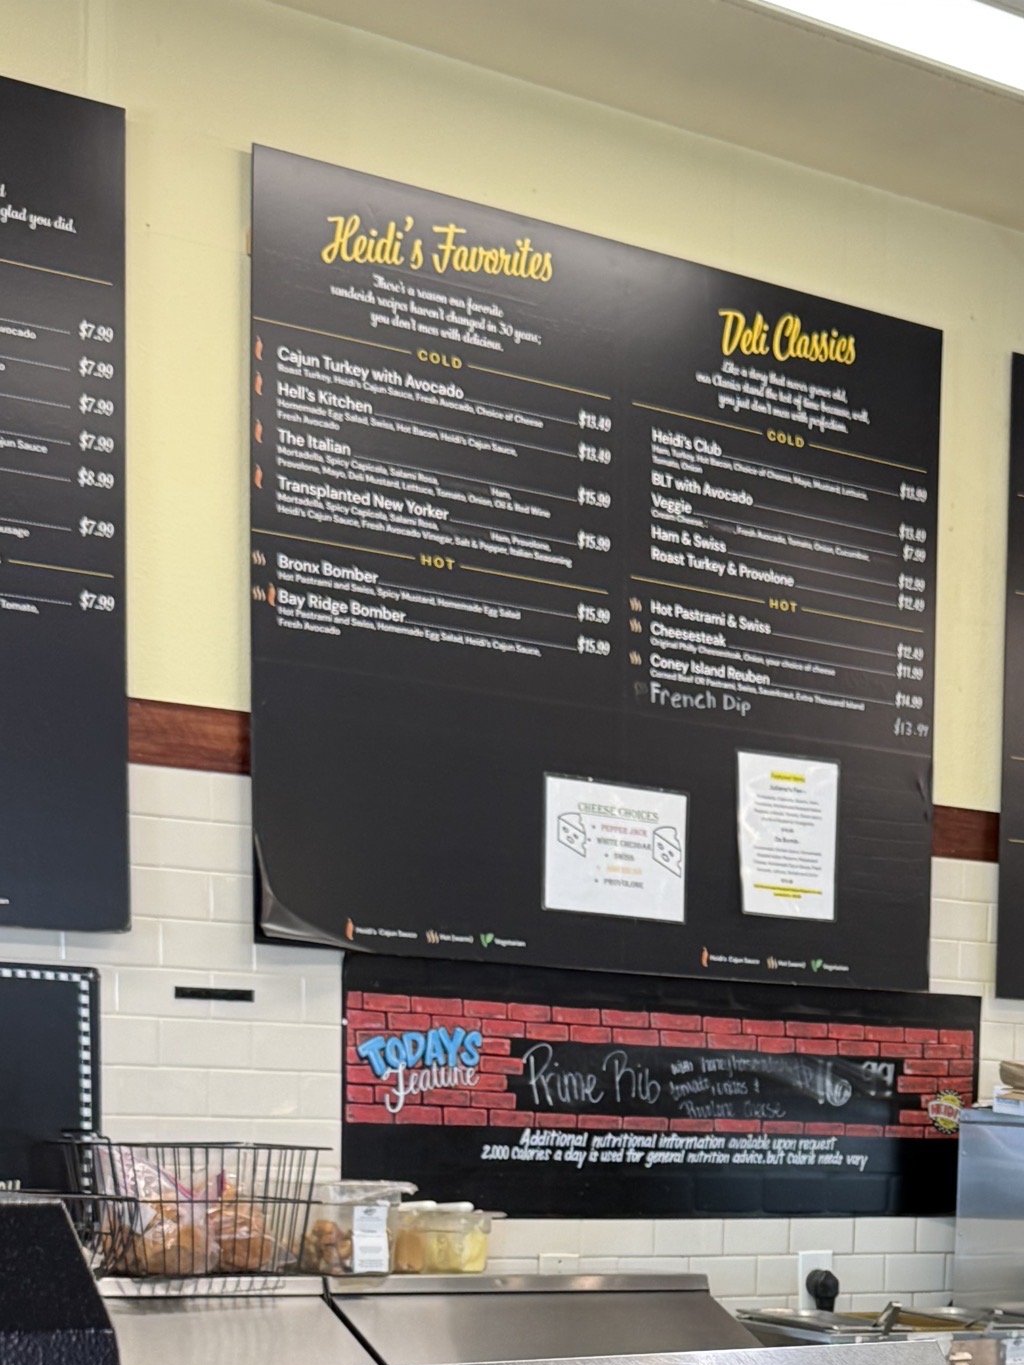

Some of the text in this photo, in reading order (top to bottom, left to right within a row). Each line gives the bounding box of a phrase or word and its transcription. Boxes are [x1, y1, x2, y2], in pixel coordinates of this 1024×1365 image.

[29, 214, 51, 230] you
[322, 215, 553, 282] Heidi's Favorites
[78, 319, 114, 346] $7.99
[718, 308, 856, 365] Deli Classics
[78, 357, 114, 383] $7.99
[277, 344, 464, 400] Cajun Turkey with Avocado
[416, 348, 462, 370] COLD
[78, 393, 114, 419] $7.99
[276, 379, 372, 415] Hell's Kitchen
[78, 430, 114, 455] $7.99
[277, 427, 350, 456] The Italian
[651, 426, 722, 457] Heidi's Club
[766, 428, 805, 448] COLD
[277, 474, 449, 521] Transplanted New Yorker
[651, 469, 753, 506] BLT with Avocado
[650, 490, 692, 516] Veggie
[78, 516, 114, 540] $7.99
[650, 523, 726, 553] Ham & Swiss
[277, 551, 378, 585] Bronx Bomber
[420, 552, 454, 571] HOT
[650, 544, 794, 587] Roast Turkey & Provolone
[78, 590, 114, 615] $7.99
[277, 587, 405, 623] Bay Ridge Bomber
[650, 598, 771, 634] Hot Pastrami & Swiss
[768, 596, 797, 613] HOT
[650, 620, 726, 647] Cheesesteak
[649, 651, 770, 686] Coney Island Reuben
[650, 682, 752, 716] French Dip
[577, 801, 660, 823] CHEESE CHOICES
[358, 1026, 482, 1079] TODAYS
[522, 1042, 604, 1106] Prime
[603, 1049, 661, 1105] Rib
[519, 1127, 589, 1147] Additional
[591, 1132, 656, 1149] nutritional
[658, 1133, 725, 1150] information
[772, 1137, 797, 1152] upon
[798, 1136, 838, 1152] request
[553, 1150, 562, 1161] a
[563, 1148, 587, 1169] day
[588, 1148, 599, 1163] is
[600, 1148, 624, 1163] used
[626, 1149, 645, 1163] for
[644, 1149, 685, 1168] general
[686, 1150, 730, 1164] nutrition
[846, 1154, 868, 1172] vary
